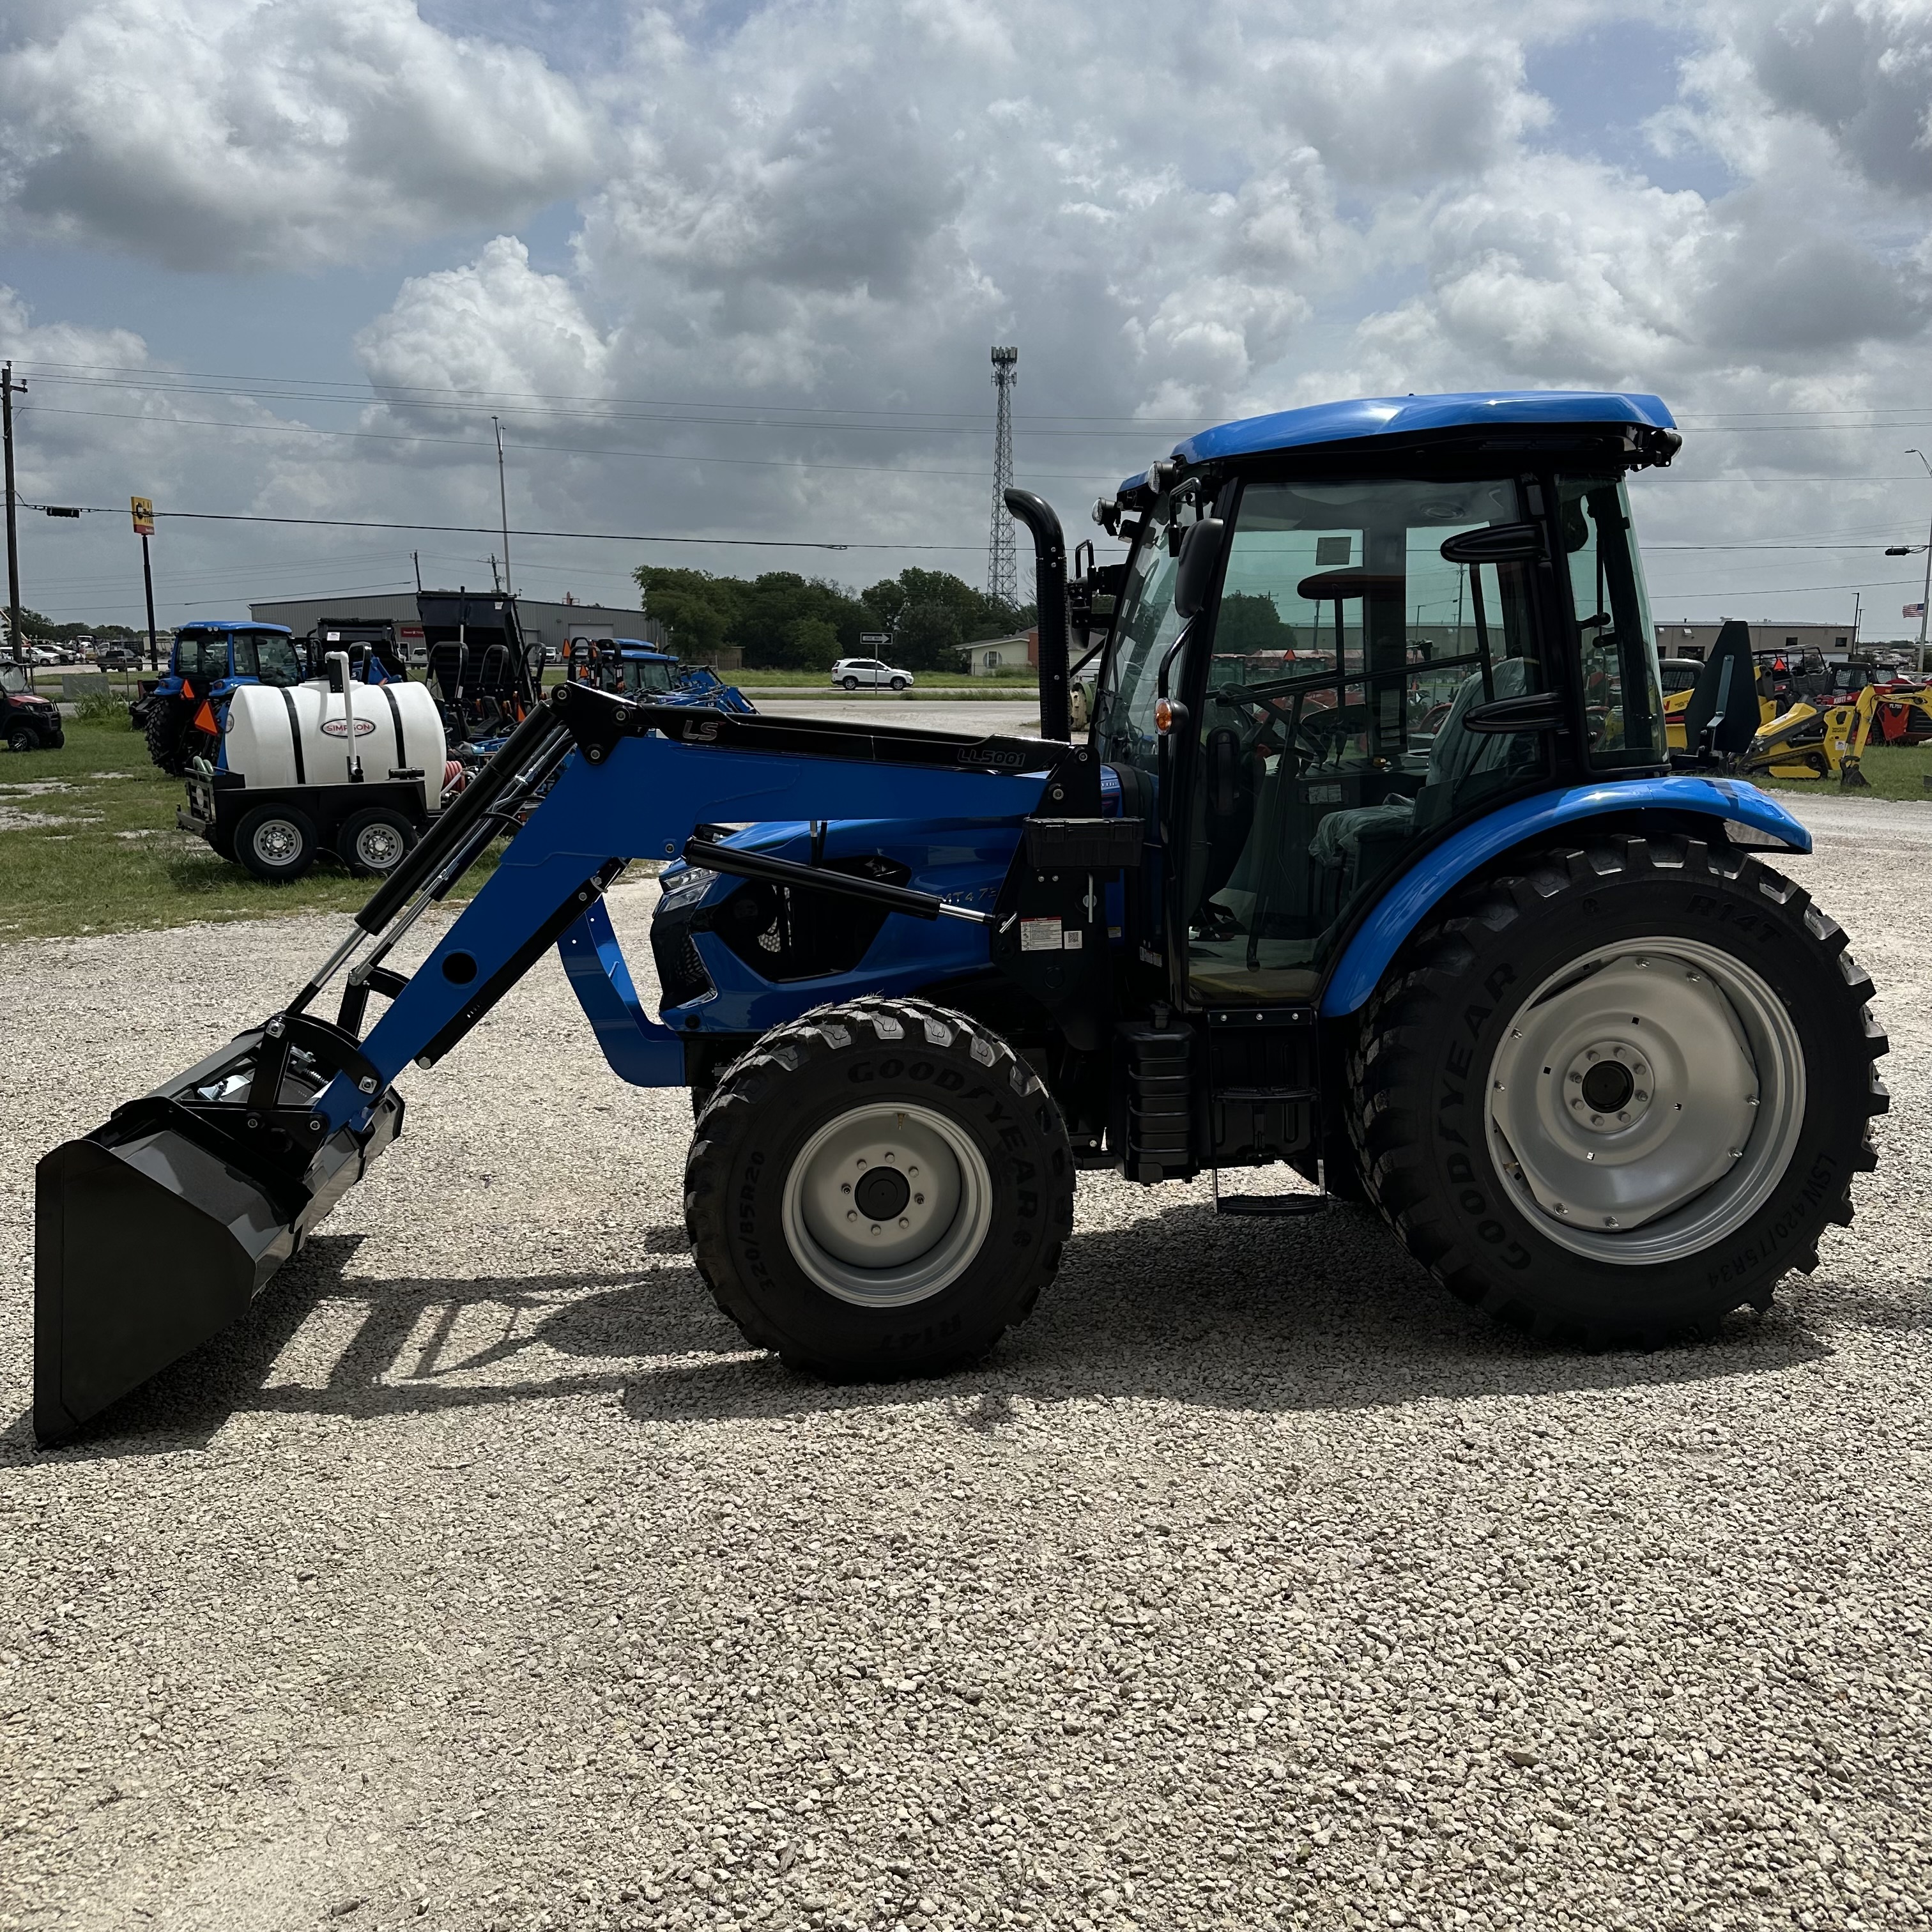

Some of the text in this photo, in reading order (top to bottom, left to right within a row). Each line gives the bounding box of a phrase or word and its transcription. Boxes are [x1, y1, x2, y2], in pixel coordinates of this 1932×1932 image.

[682, 720, 718, 740] LS
[958, 748, 1025, 766] LL5001
[1685, 893, 1782, 943] R14T
[848, 1059, 1038, 1219] GOODYEAR
[1438, 962, 1531, 1271] GOODYEAR
[738, 1151, 776, 1292] 320/85R20
